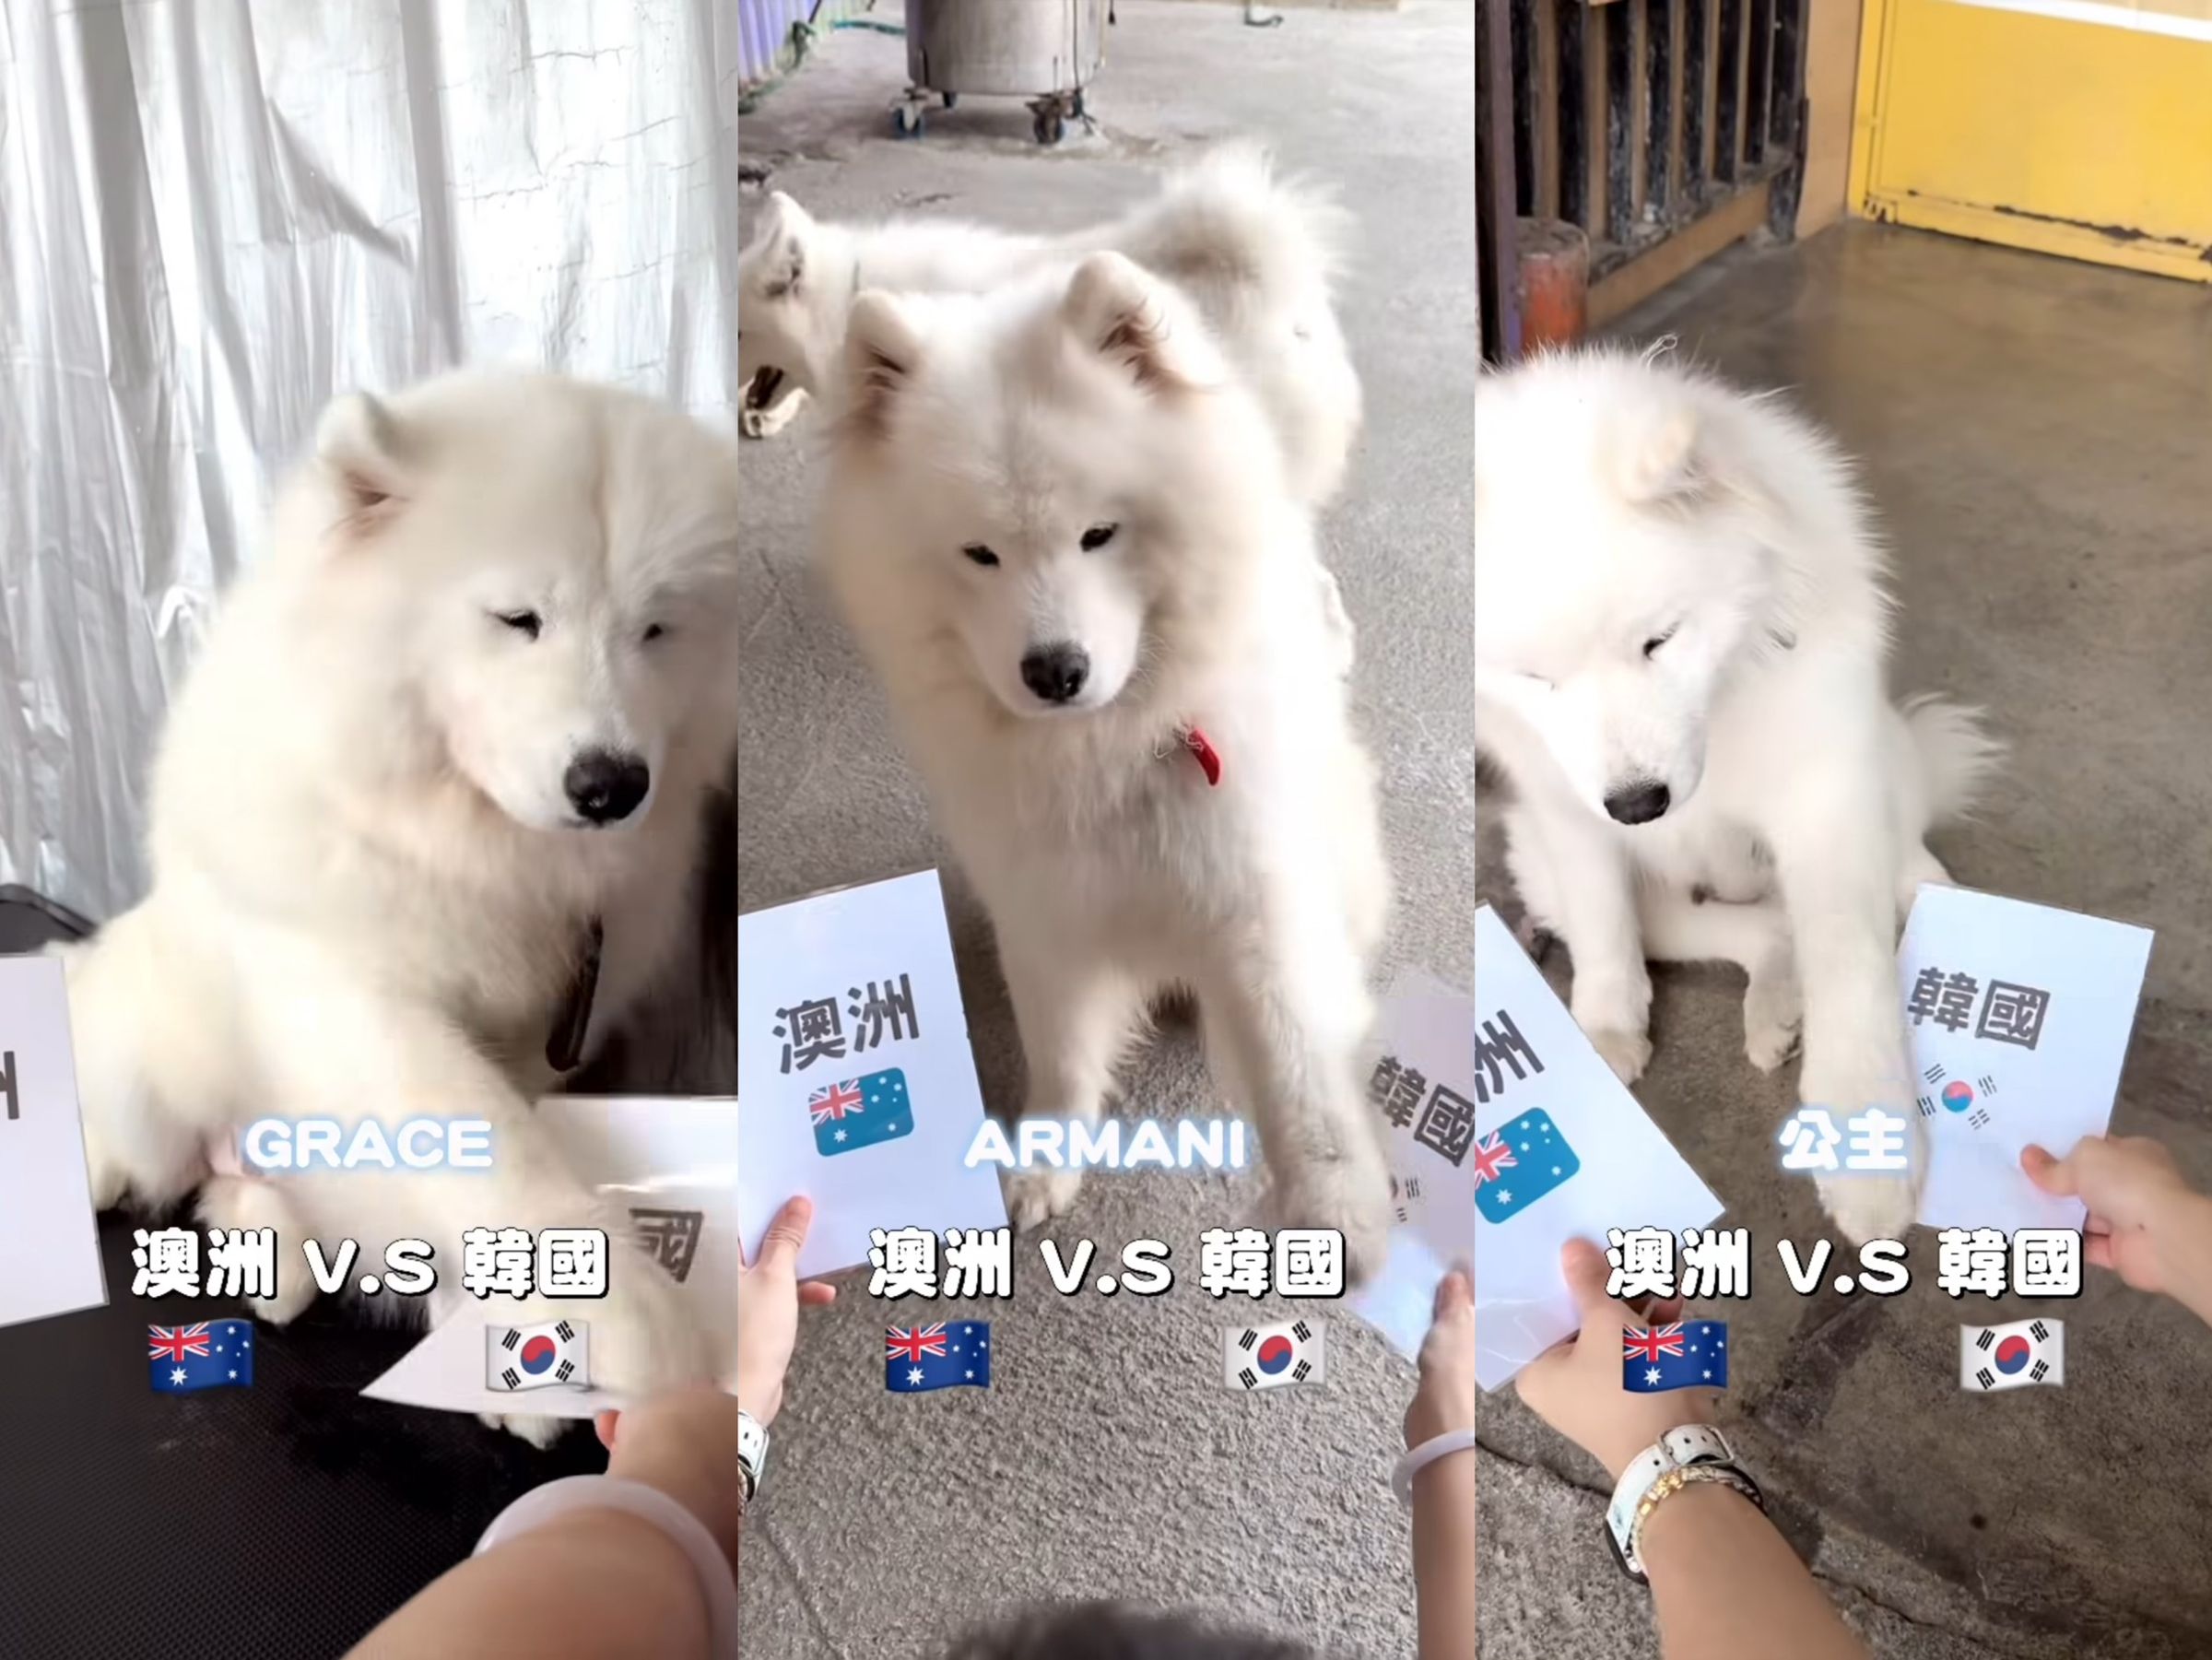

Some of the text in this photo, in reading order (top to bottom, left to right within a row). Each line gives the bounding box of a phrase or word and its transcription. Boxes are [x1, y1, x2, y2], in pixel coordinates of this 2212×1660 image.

[772, 973, 920, 1074] 澳洲
[1908, 966, 2051, 1051] 韓國
[1367, 1055, 1475, 1168] 韓國
